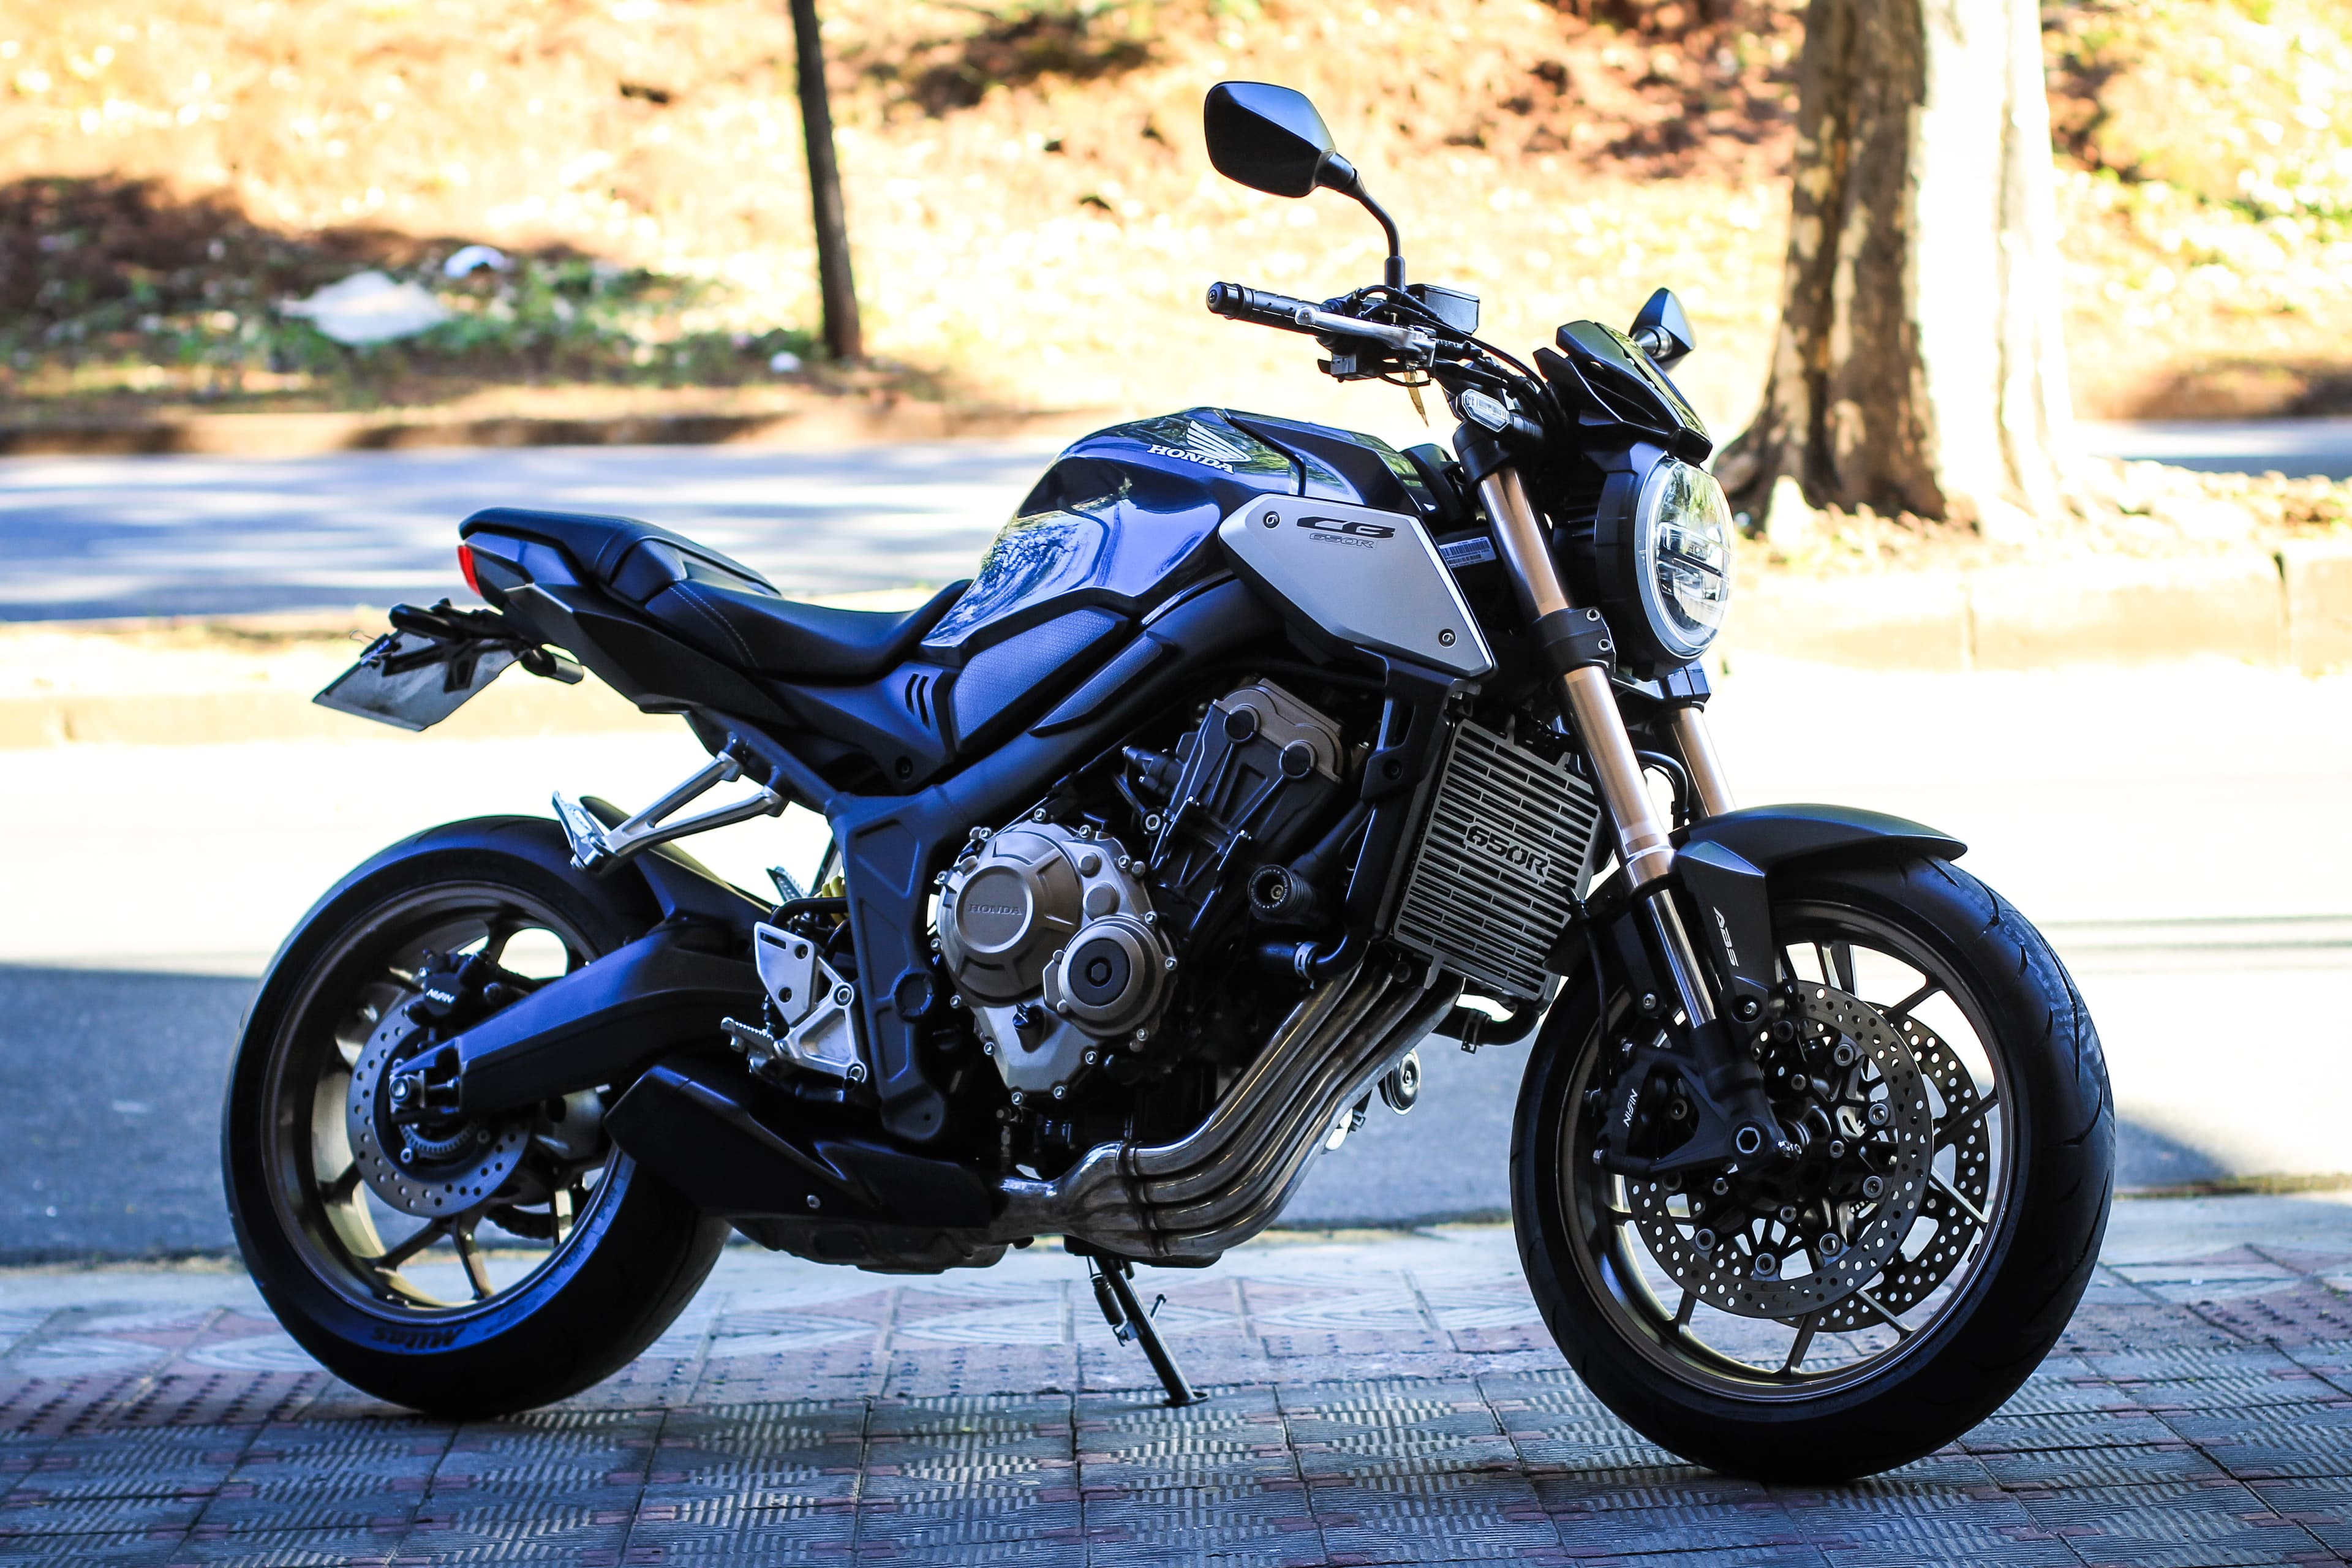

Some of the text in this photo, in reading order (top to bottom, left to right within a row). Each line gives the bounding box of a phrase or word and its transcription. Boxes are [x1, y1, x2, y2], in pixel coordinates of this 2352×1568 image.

[1147, 444, 1235, 475] HONDA
[1297, 516, 1396, 538] CB
[1310, 532, 1374, 549] 650R
[1466, 825, 1548, 877] 650R
[970, 903, 1022, 915] HONDA
[1713, 906, 1739, 967] ABS
[1623, 1088, 1638, 1127] NISSIN
